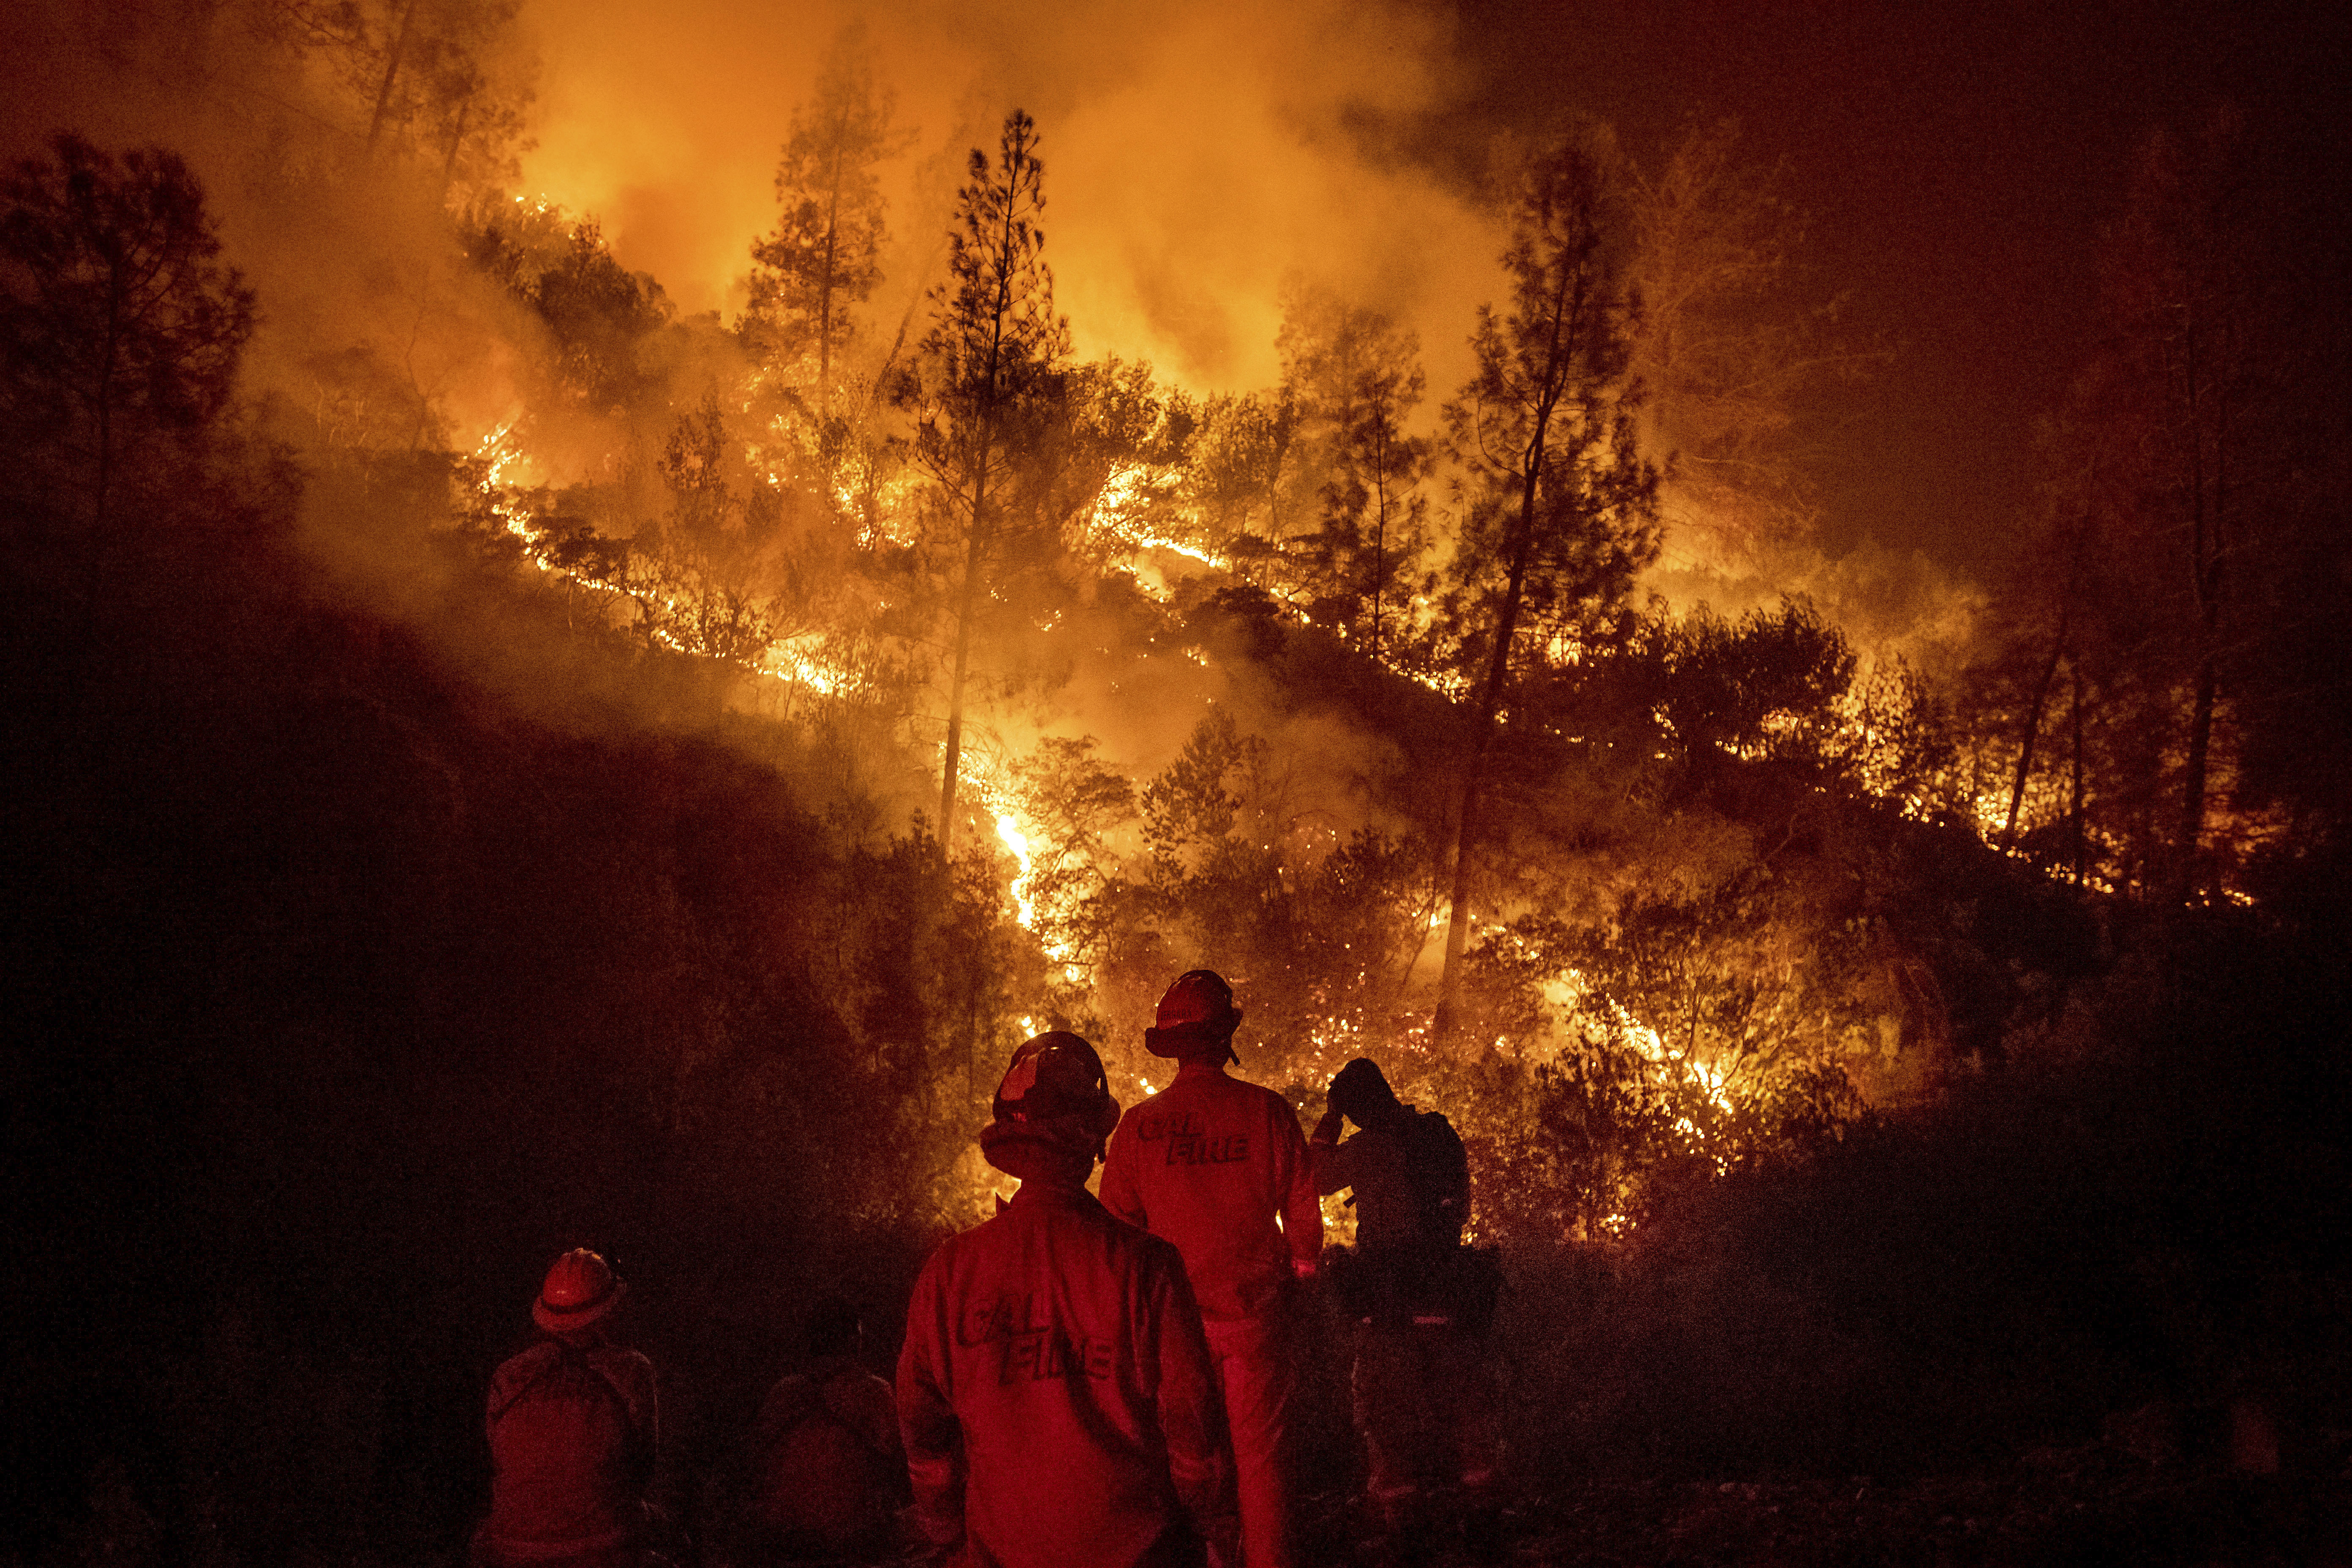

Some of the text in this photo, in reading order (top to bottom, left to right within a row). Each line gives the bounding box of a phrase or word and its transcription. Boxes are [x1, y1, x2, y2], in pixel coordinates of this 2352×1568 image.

[1137, 1111, 1203, 1142] CAL
[1166, 1132, 1250, 1167] FIRE
[957, 1291, 1051, 1348] CAL
